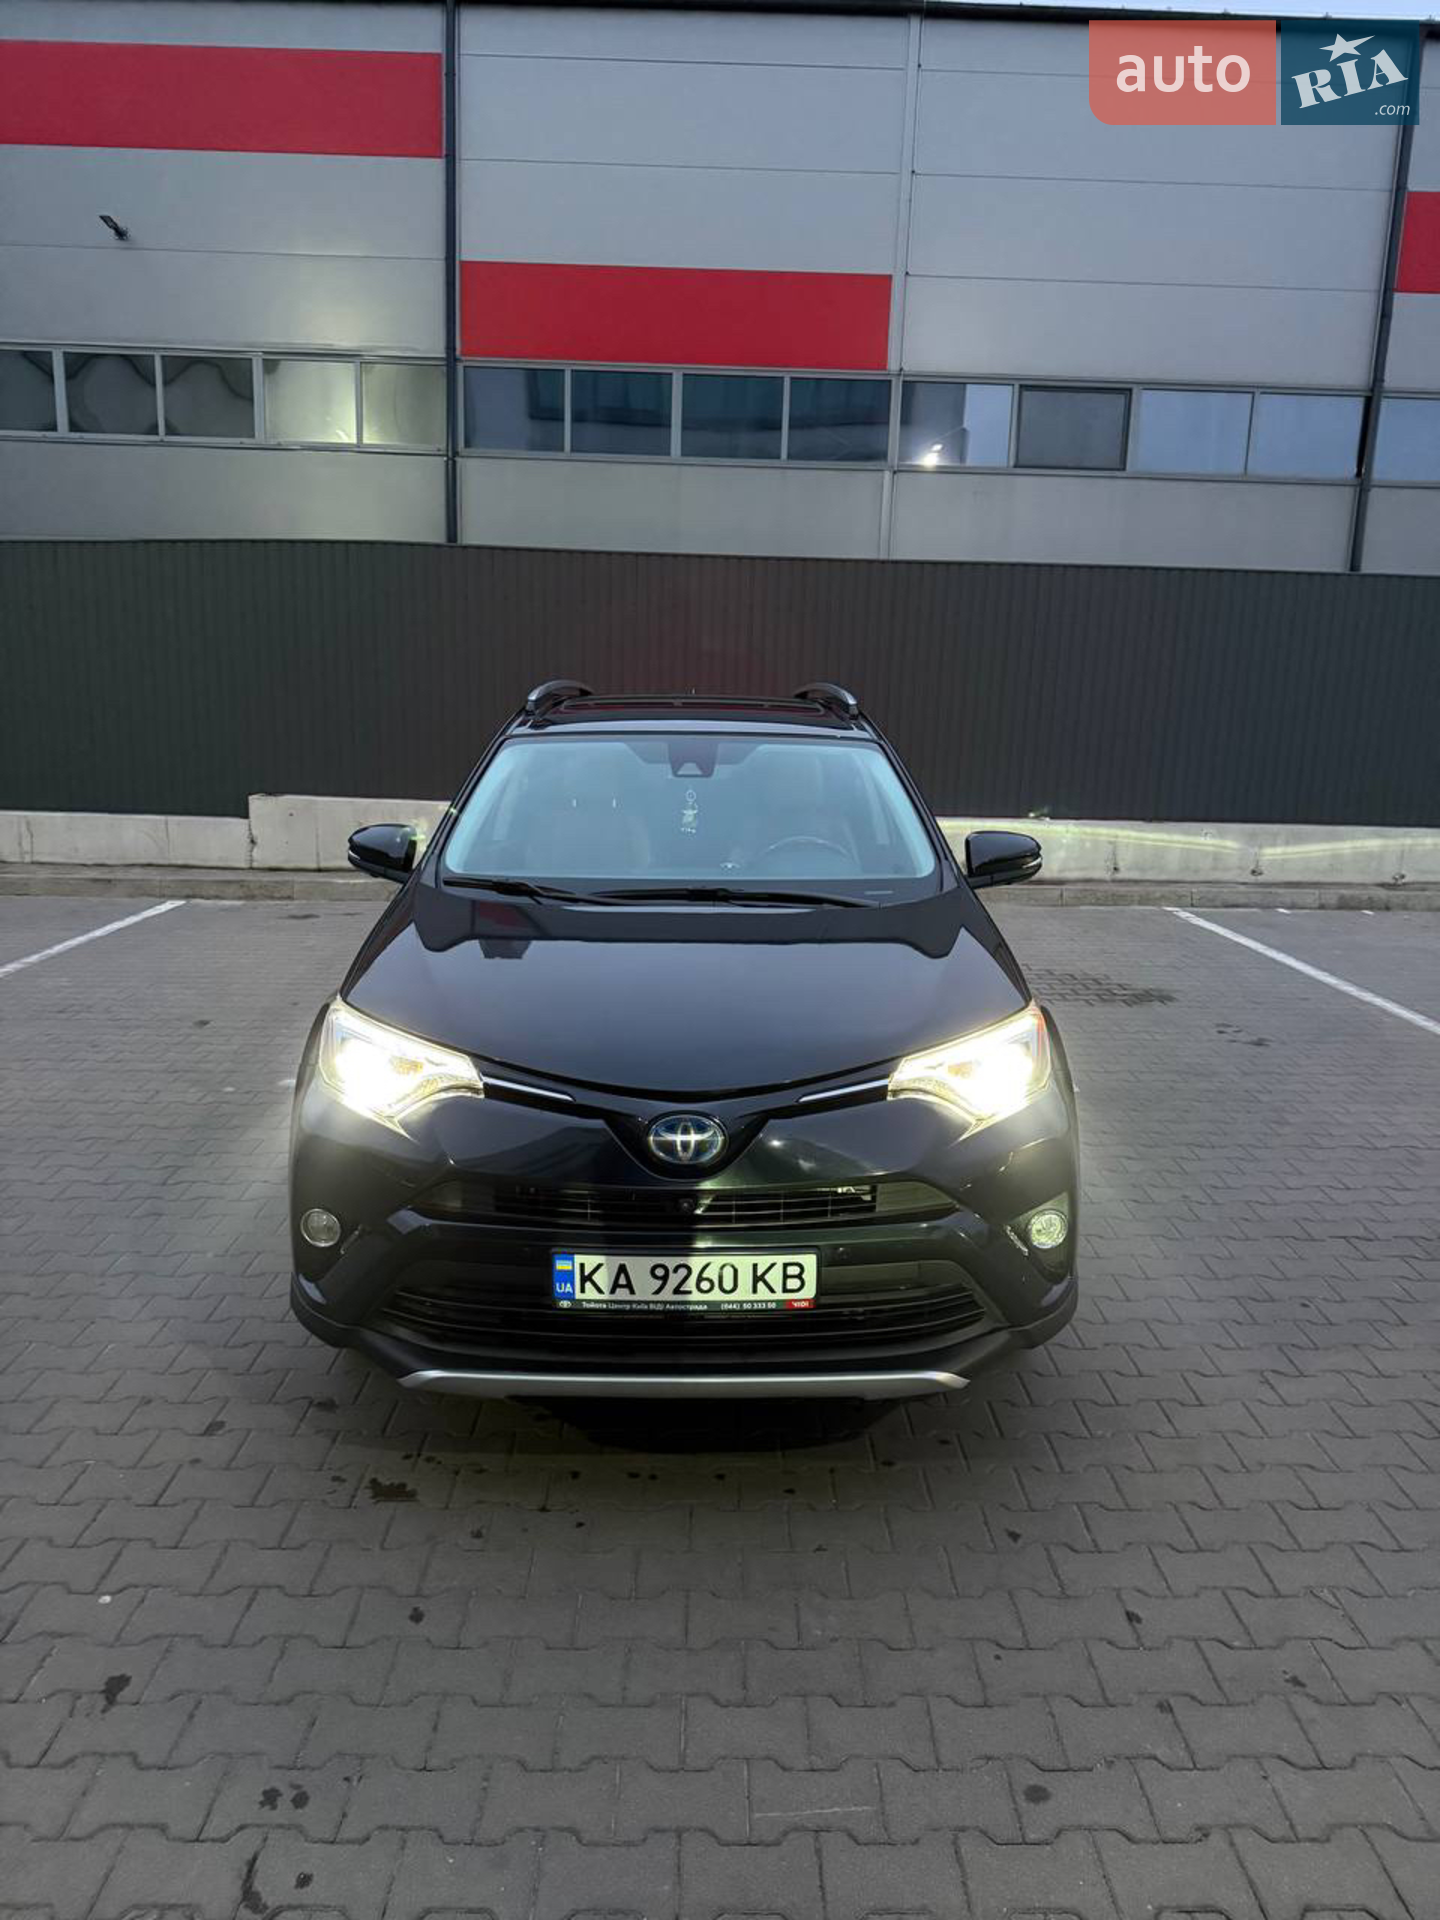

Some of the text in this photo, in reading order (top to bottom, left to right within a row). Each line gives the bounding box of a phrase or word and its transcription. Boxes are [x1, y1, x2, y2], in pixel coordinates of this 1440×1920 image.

[556, 1283, 574, 1294] UA
[579, 1262, 806, 1295] KA 9260 KB
